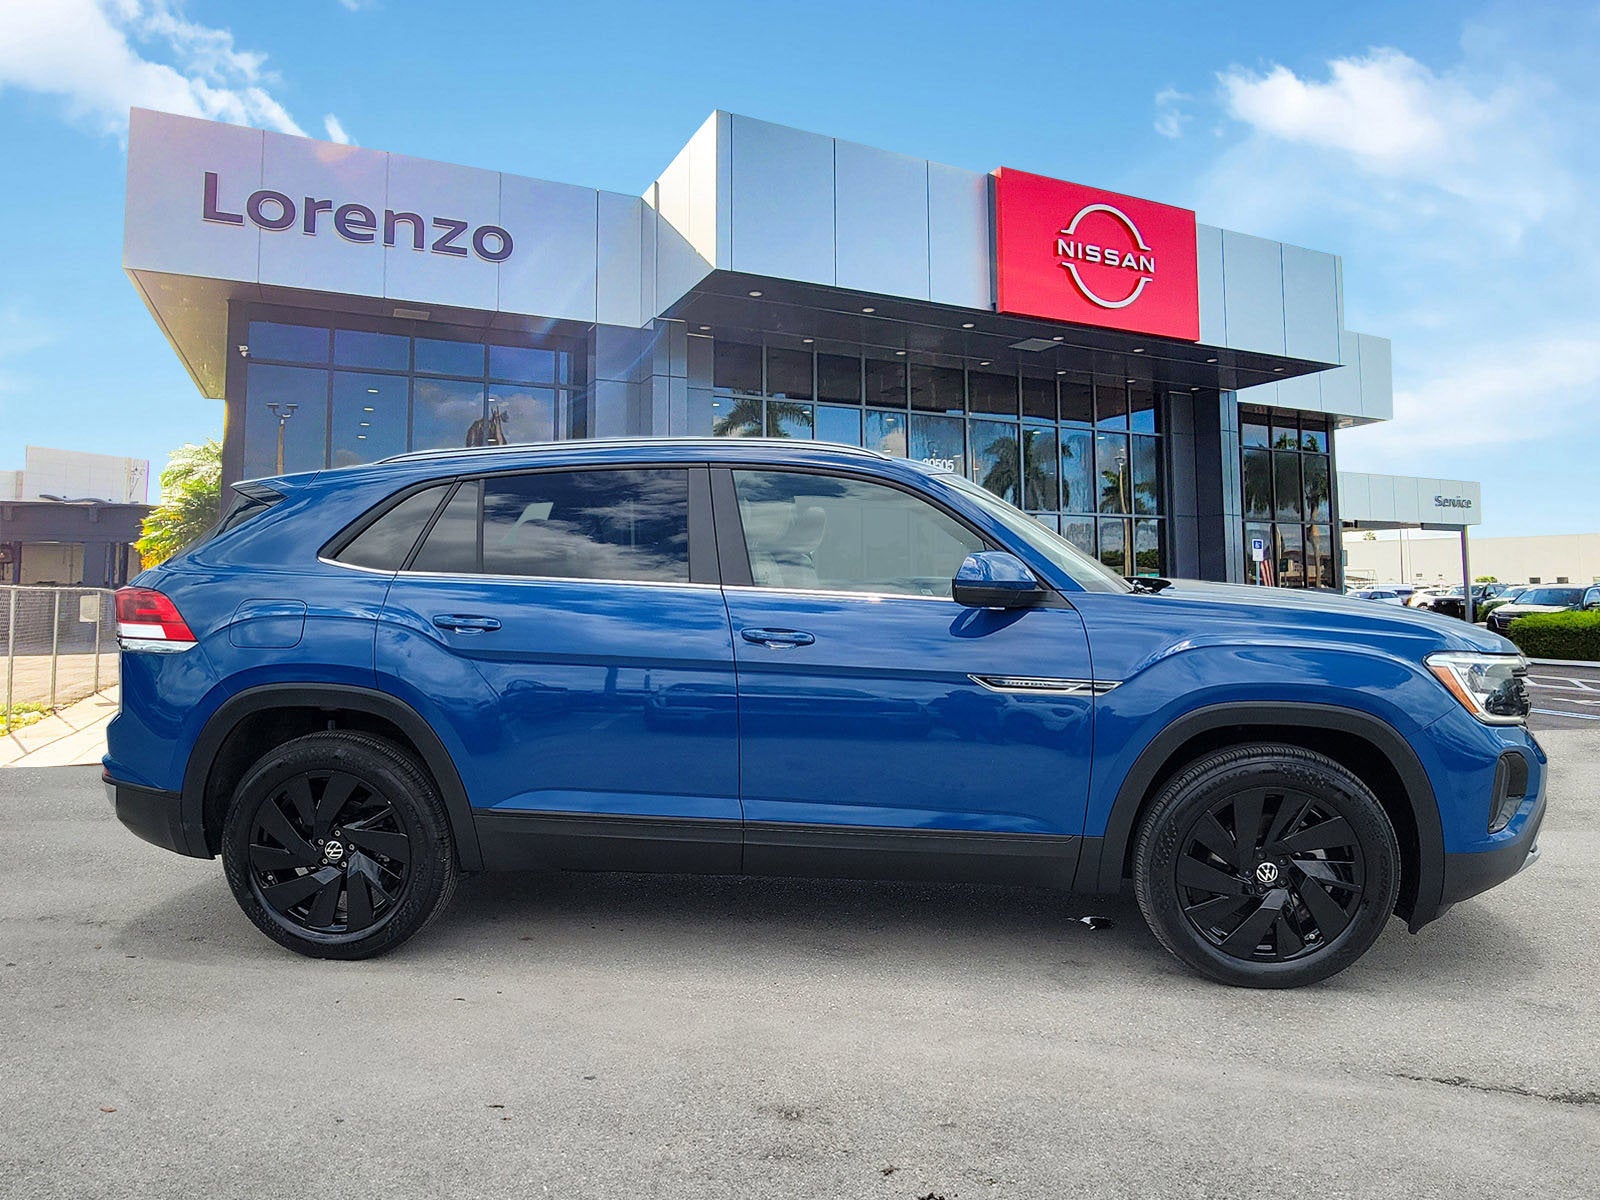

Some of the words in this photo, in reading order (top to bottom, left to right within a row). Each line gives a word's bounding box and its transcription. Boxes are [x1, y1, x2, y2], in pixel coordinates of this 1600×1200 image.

[203, 171, 515, 263] Lorenzo
[1056, 238, 1156, 274] NISSAN
[1434, 495, 1472, 509] Service
